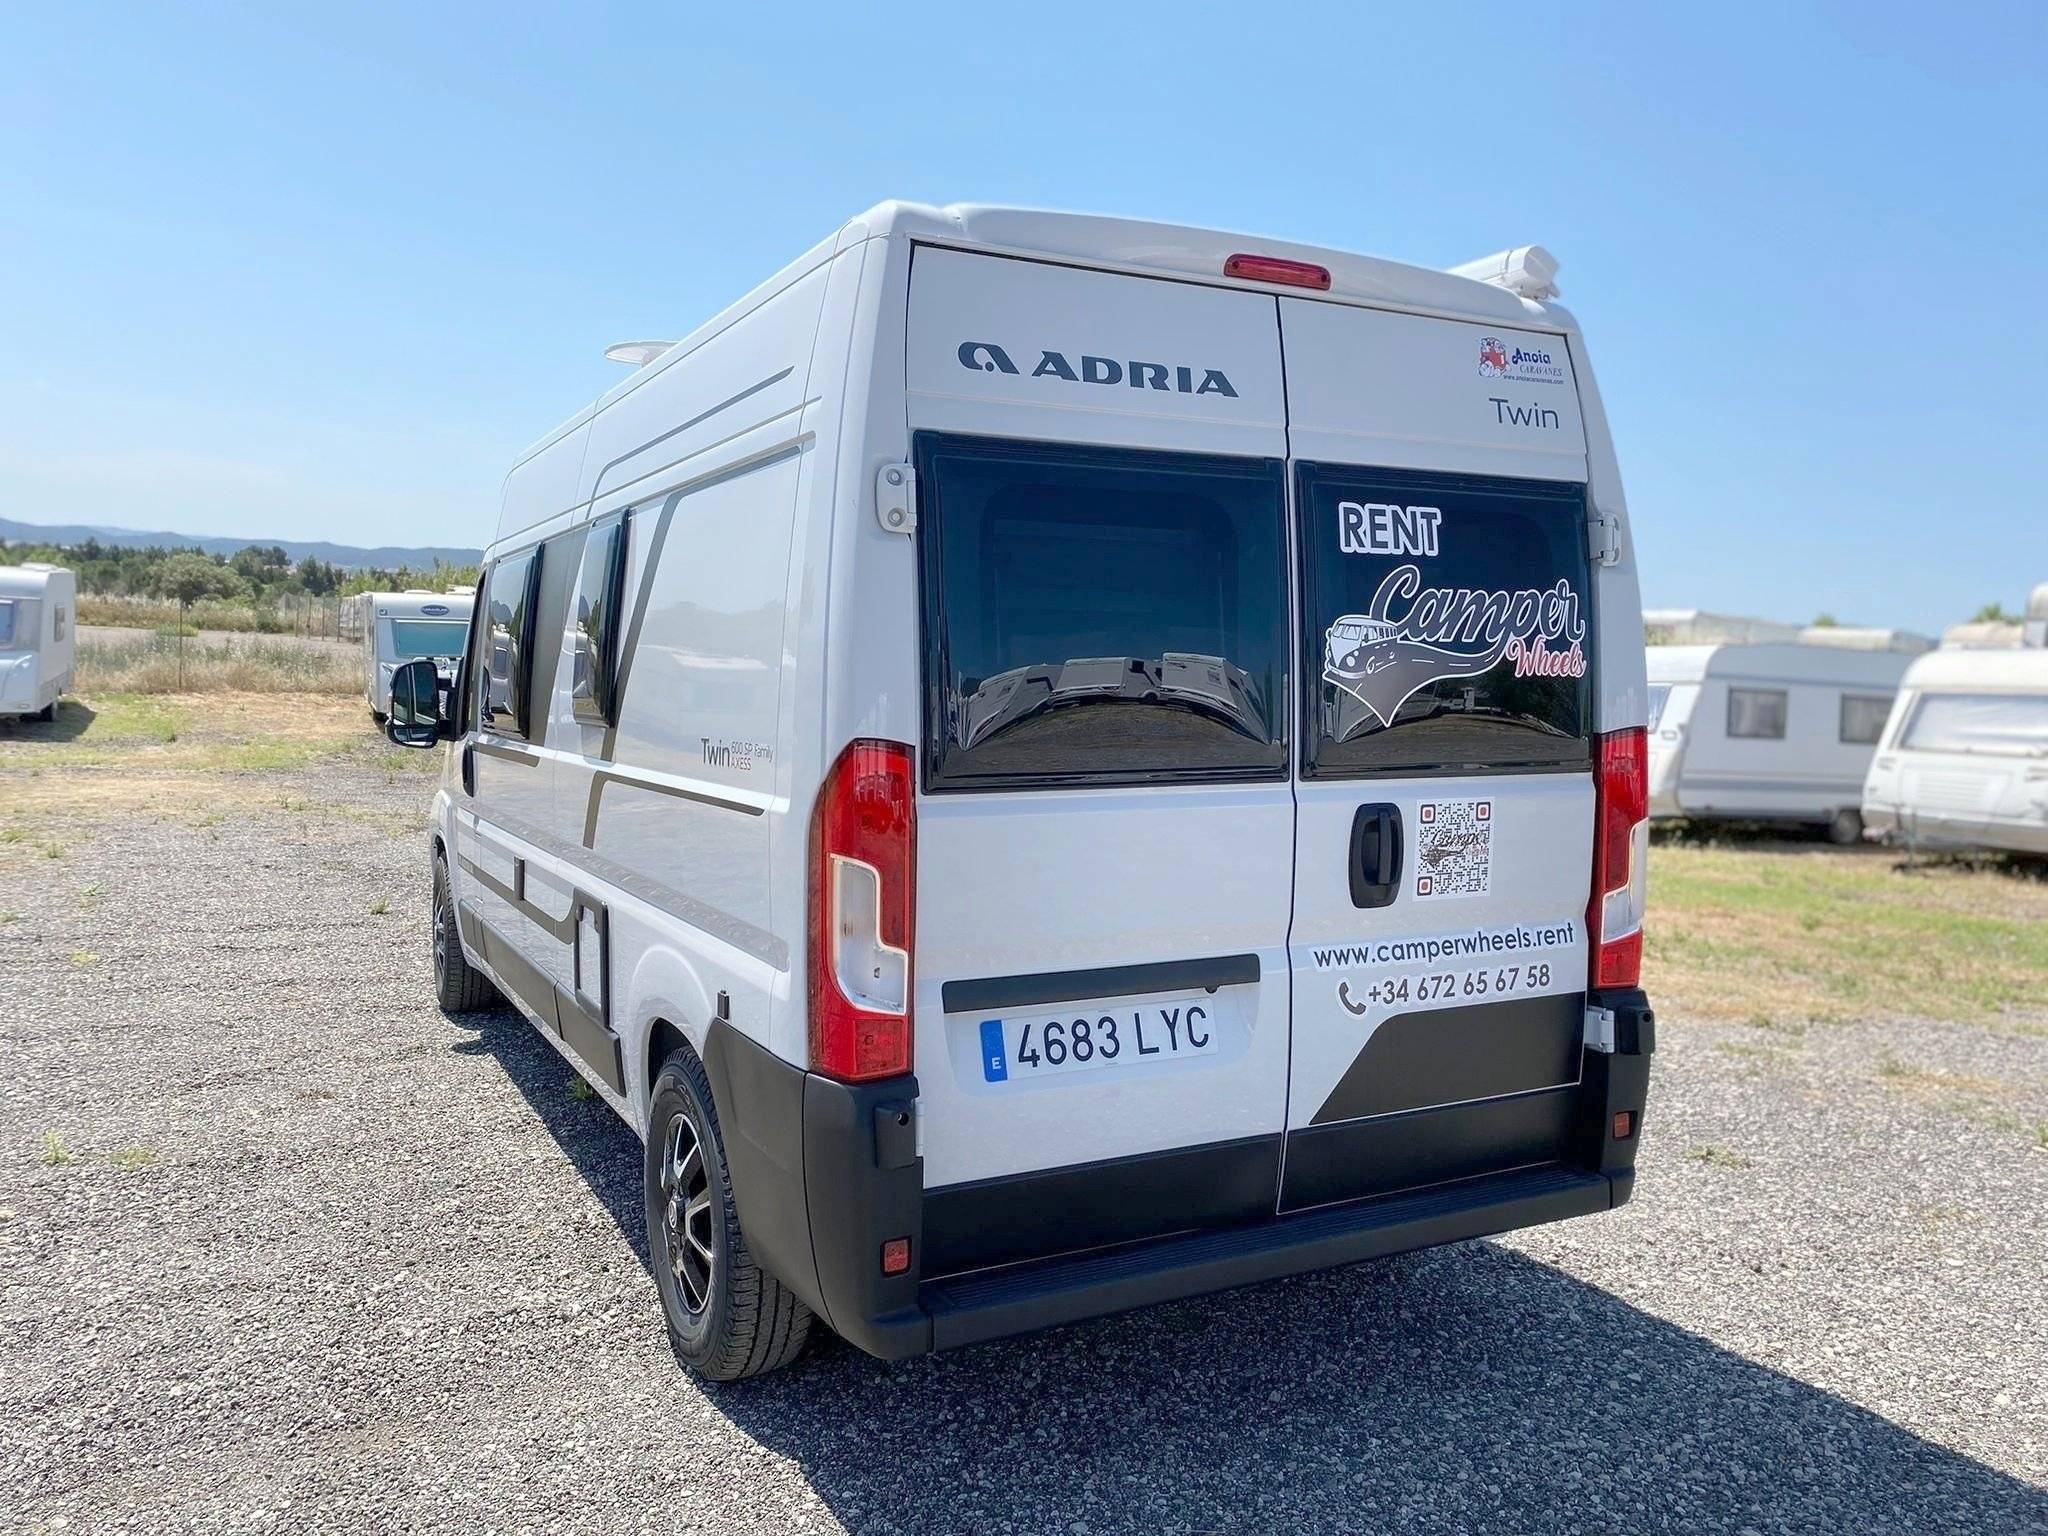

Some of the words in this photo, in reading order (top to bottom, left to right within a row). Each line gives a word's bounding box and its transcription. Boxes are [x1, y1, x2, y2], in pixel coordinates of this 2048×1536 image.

[1031, 350, 1240, 398] ADRIA
[1511, 347, 1551, 365] Anoia
[1520, 365, 1562, 376] CARAVANES
[1488, 397, 1559, 429] Twin
[1338, 502, 1441, 556] RENT
[1369, 564, 1586, 657] Camper
[1505, 635, 1587, 678] Wheels
[701, 738, 731, 767] Twin
[731, 757, 751, 771] AXESS
[1313, 922, 1575, 967] www.camperwheels.rent
[1368, 977, 1410, 1005] +34
[1416, 974, 1456, 1002] 672
[1463, 970, 1488, 996] 65
[1495, 967, 1520, 993] 67
[1526, 963, 1551, 989] 58
[1017, 1015, 1121, 1068] 4683
[1133, 1006, 1210, 1055] LYC
[991, 1057, 1002, 1070] E
